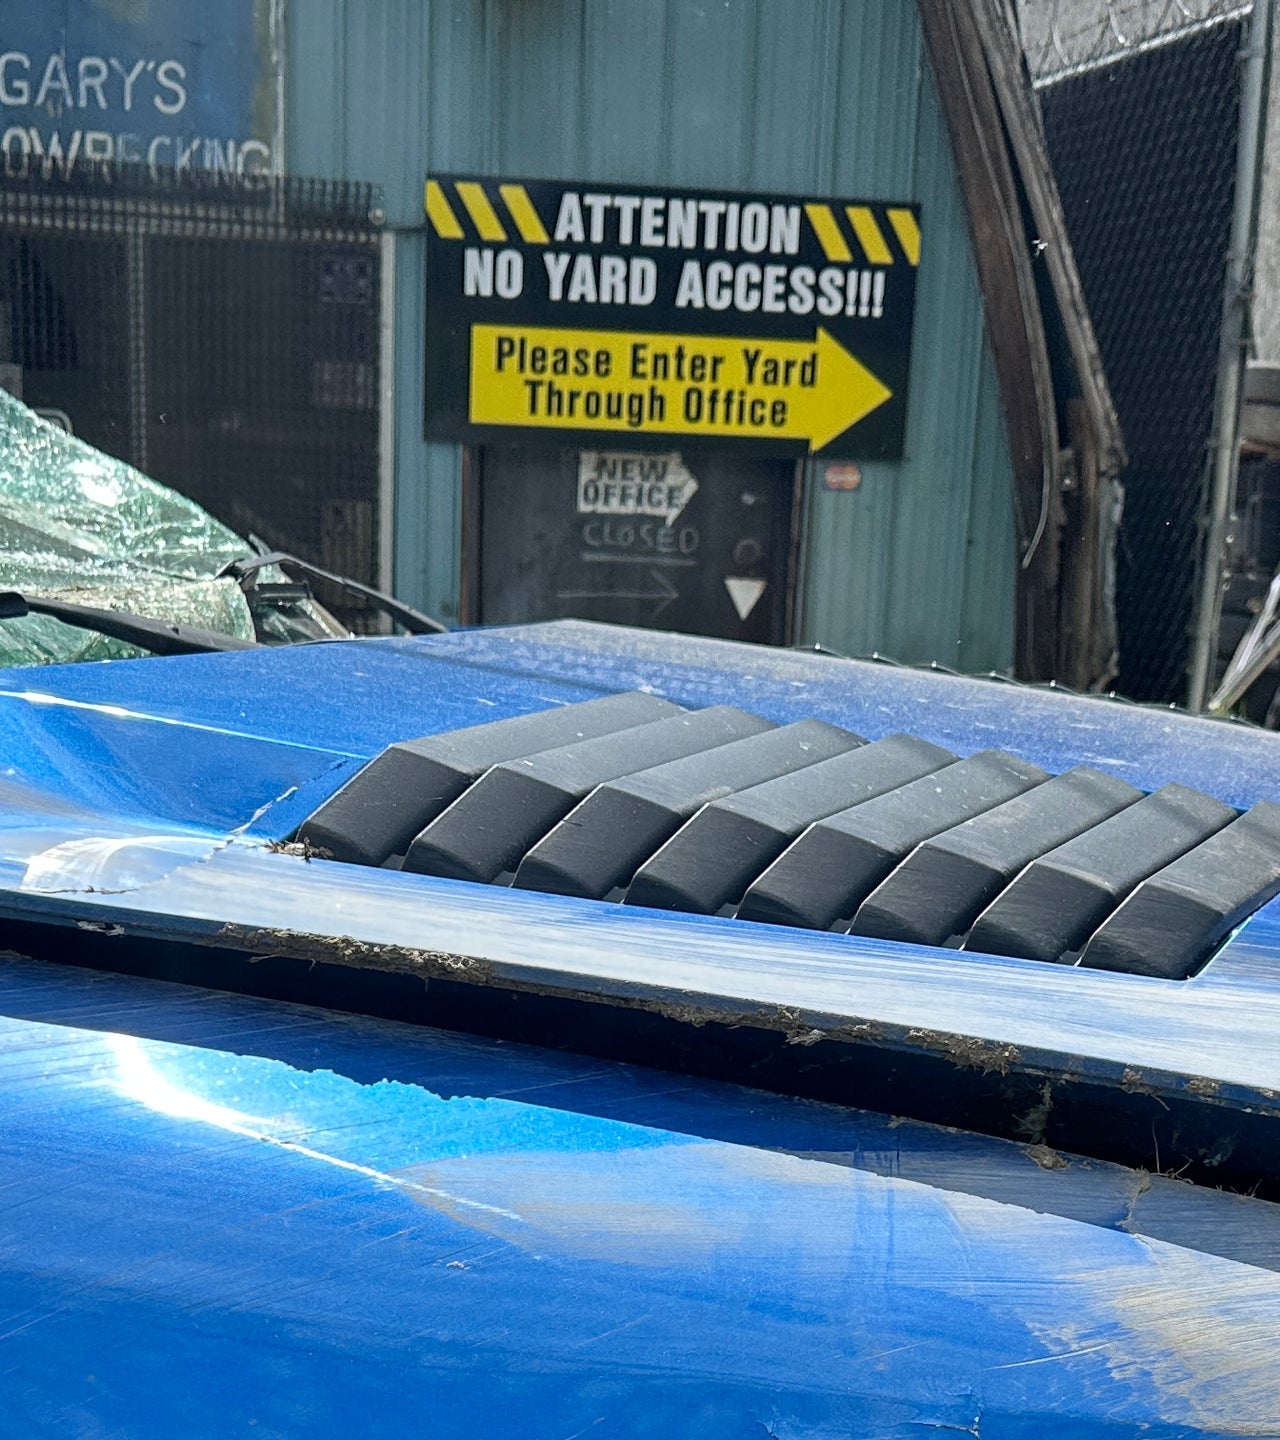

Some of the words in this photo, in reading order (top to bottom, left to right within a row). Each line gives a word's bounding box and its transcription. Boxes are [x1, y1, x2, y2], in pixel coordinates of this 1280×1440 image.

[554, 192, 802, 254] ATTENTION
[464, 247, 524, 300] NO
[543, 252, 657, 306] YARD
[676, 260, 886, 318] ACCESS!!!
[494, 336, 611, 377] Please
[631, 343, 724, 384] Enter
[742, 349, 819, 388] Yard
[525, 380, 666, 428] Through
[684, 386, 788, 427] Office
[583, 480, 683, 508] OFFICE
[597, 457, 668, 481] NEW
